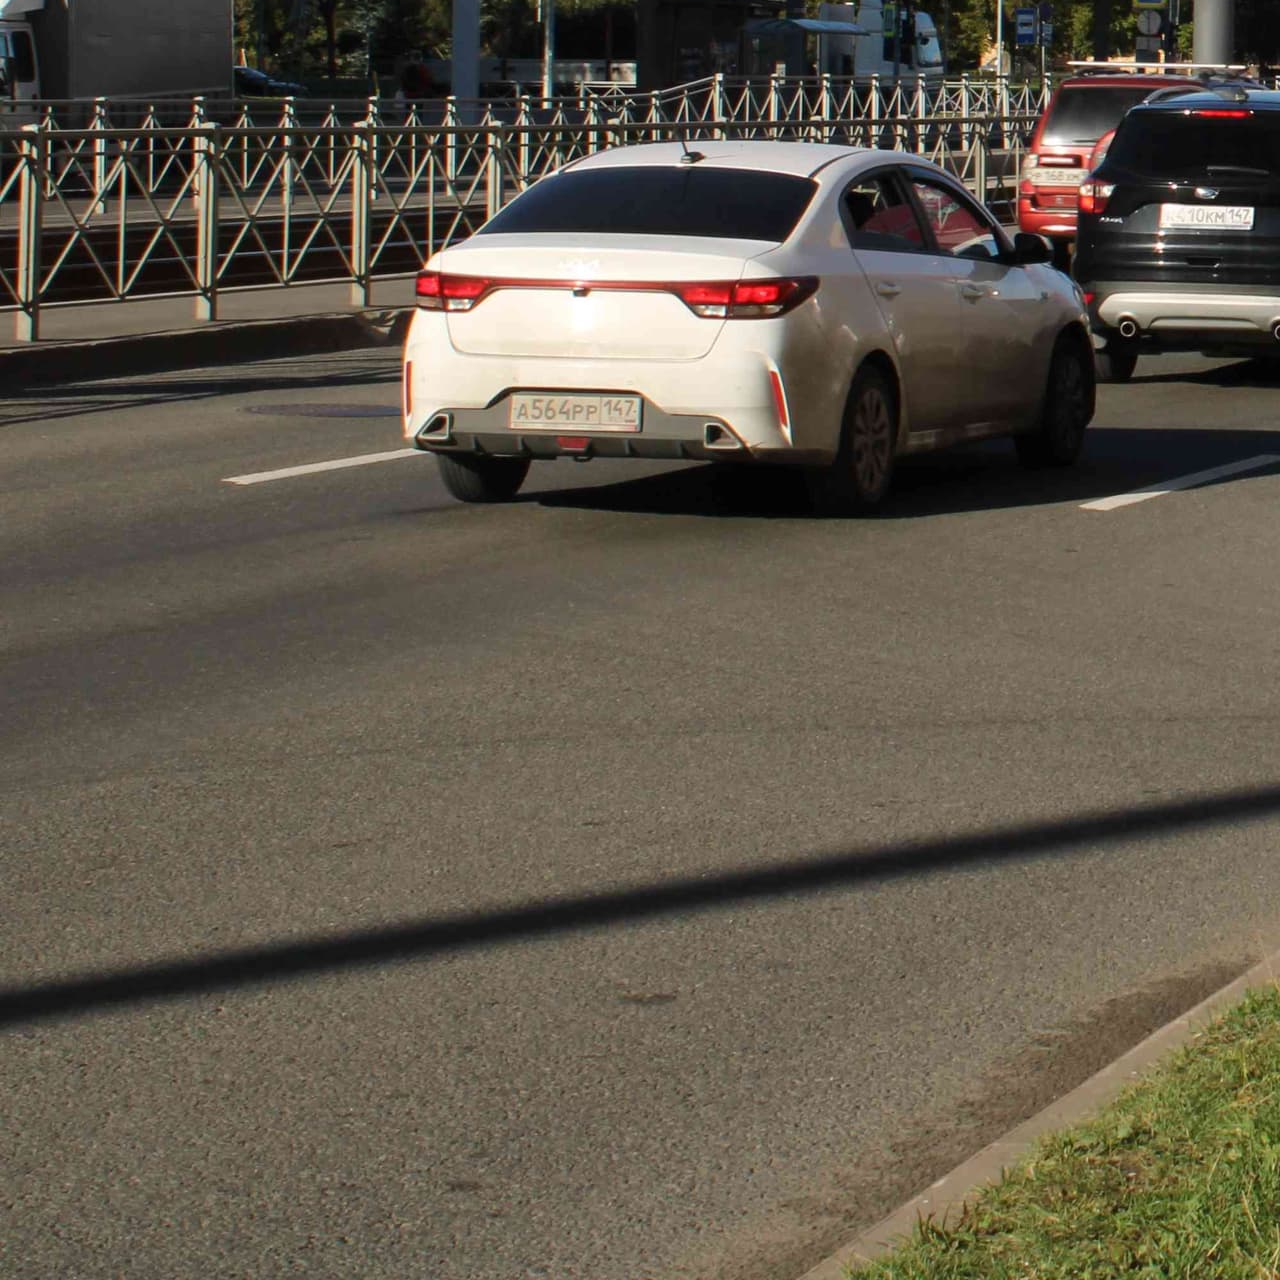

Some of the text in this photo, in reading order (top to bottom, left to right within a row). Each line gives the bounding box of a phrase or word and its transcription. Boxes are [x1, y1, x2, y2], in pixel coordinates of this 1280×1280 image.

[1229, 208, 1250, 220] 147
[518, 399, 635, 421] А564РР 147
